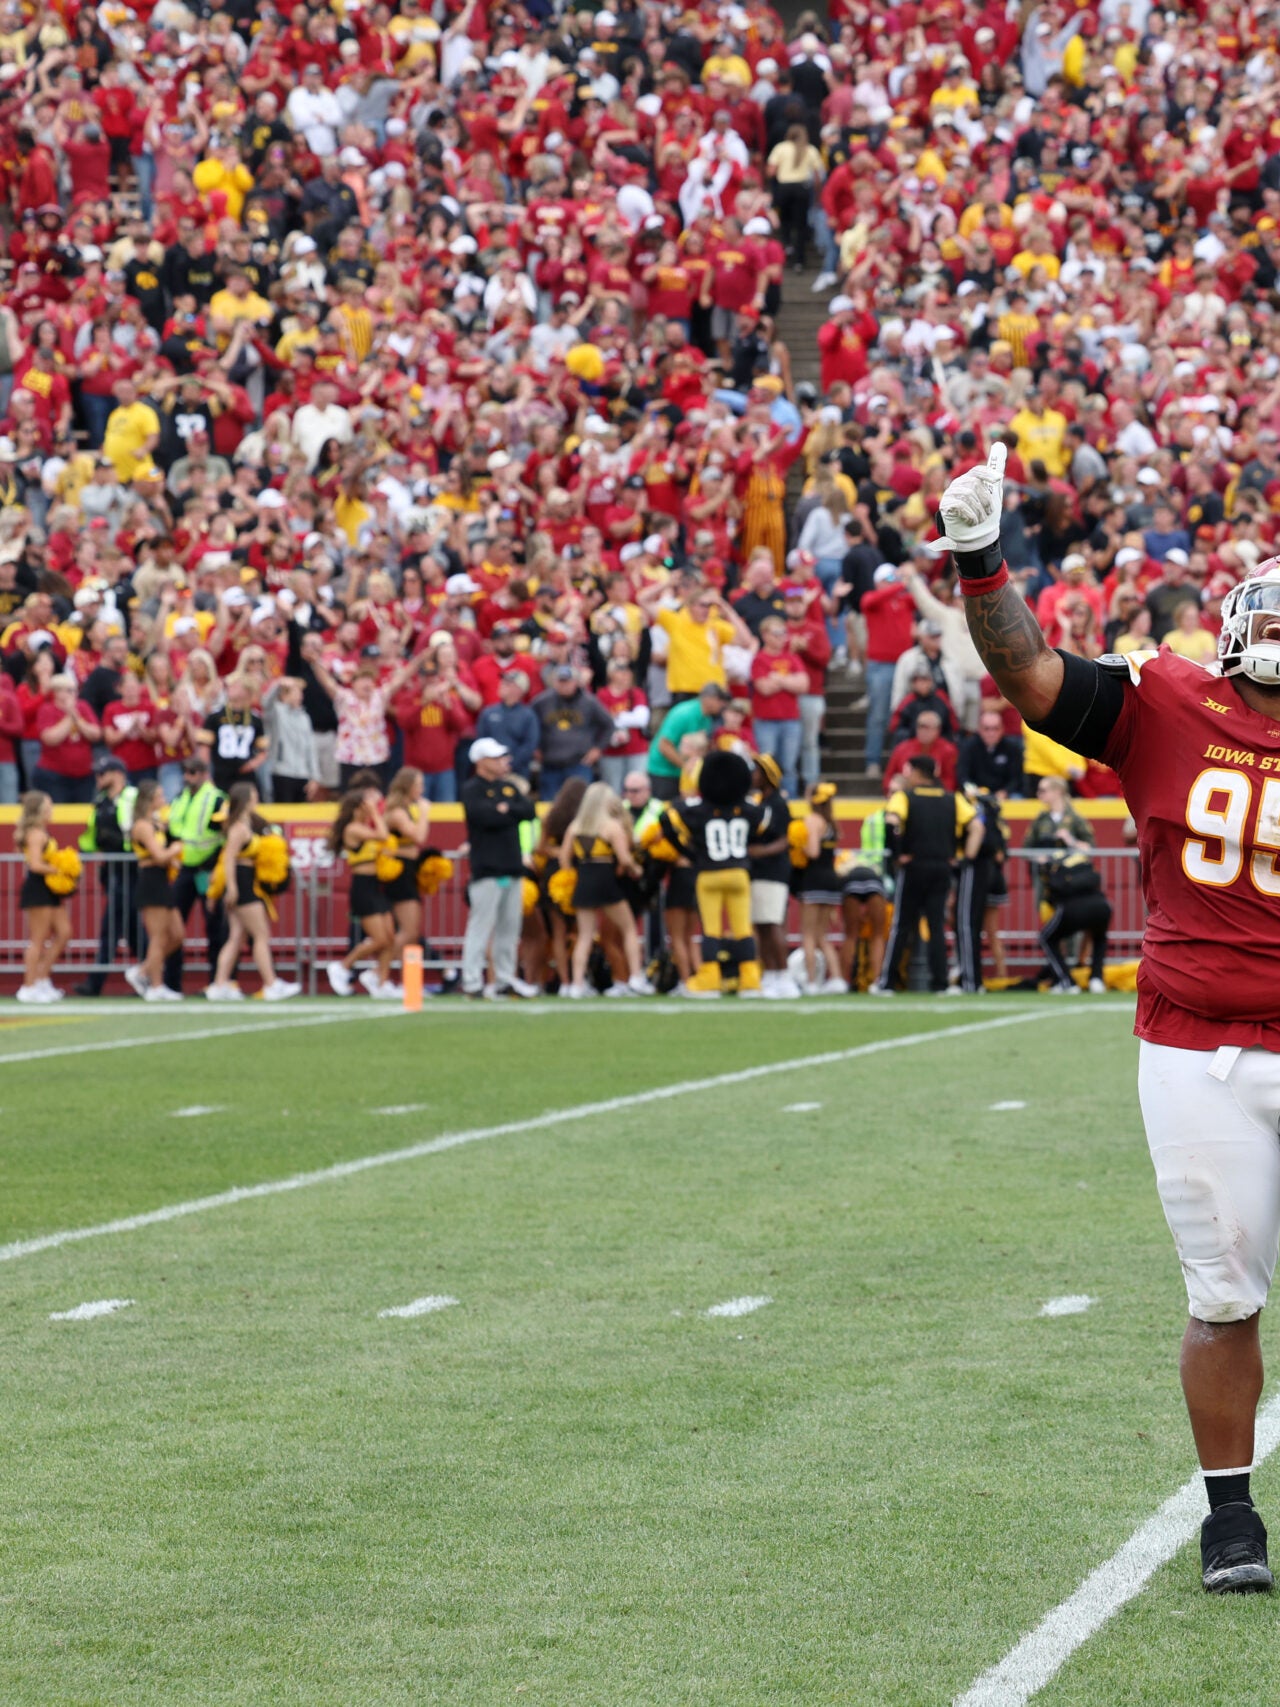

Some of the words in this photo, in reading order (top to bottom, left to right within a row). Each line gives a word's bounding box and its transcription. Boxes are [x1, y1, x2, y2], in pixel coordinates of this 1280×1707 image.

[218, 724, 255, 759] 87
[1203, 744, 1256, 767] IOWA
[705, 818, 750, 861] 00
